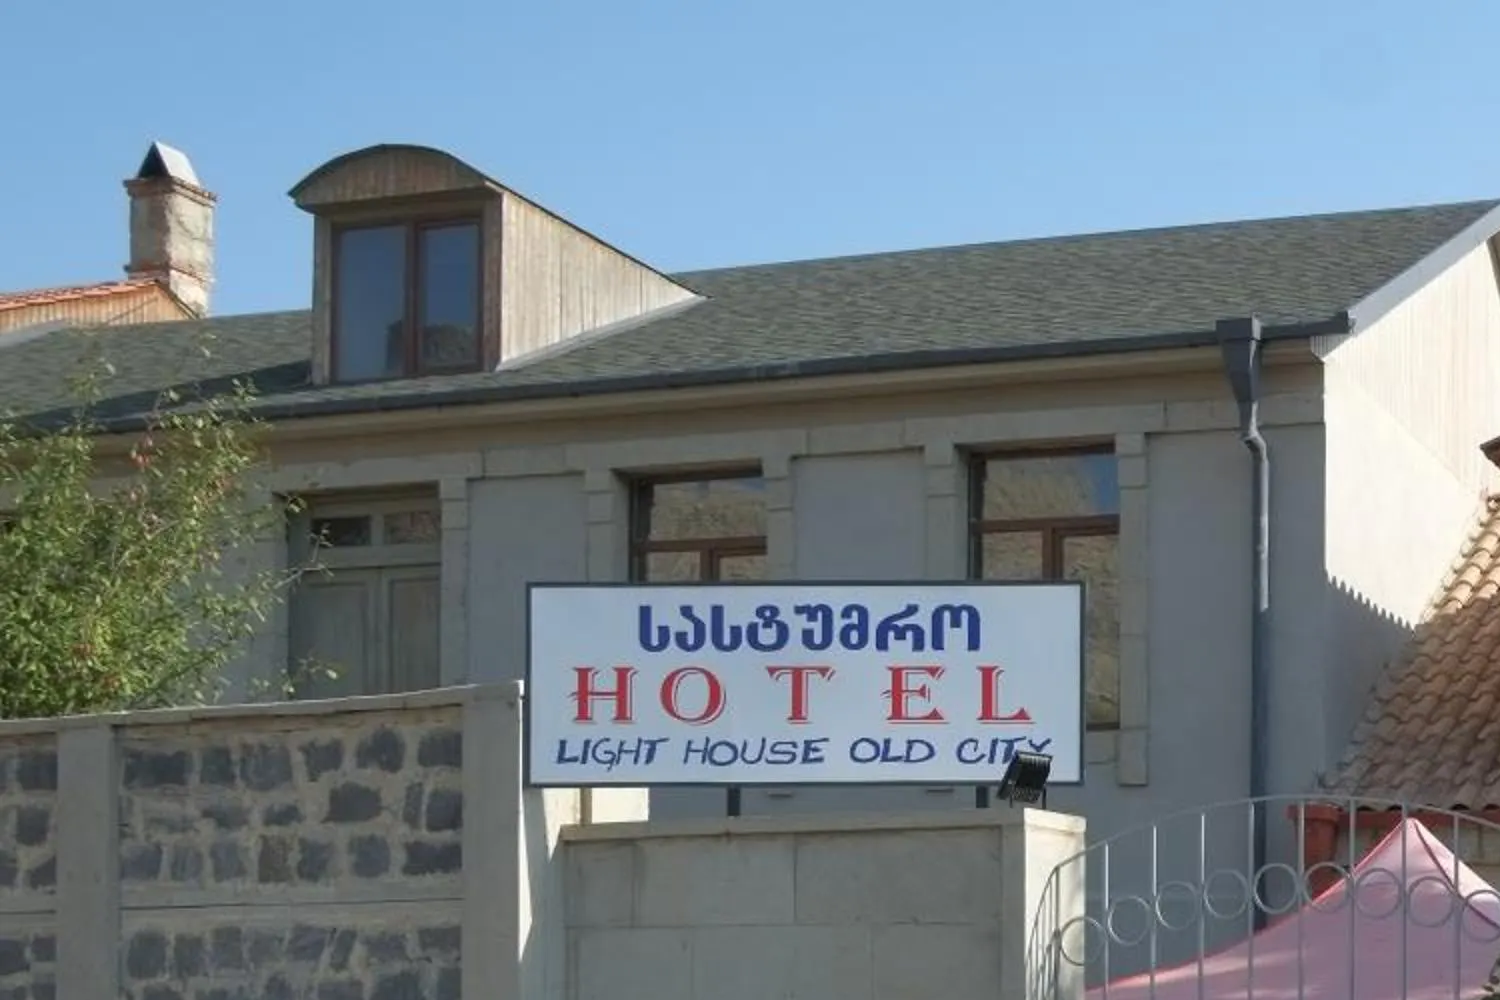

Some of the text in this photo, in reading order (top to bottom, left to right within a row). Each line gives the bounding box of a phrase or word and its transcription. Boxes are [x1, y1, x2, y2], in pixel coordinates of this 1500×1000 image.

[638, 603, 981, 653] სასტუმრო
[569, 665, 1036, 726] HOTEL
[556, 736, 670, 773] LIGHT
[683, 736, 830, 766] HOUSE
[848, 736, 938, 764] OLD
